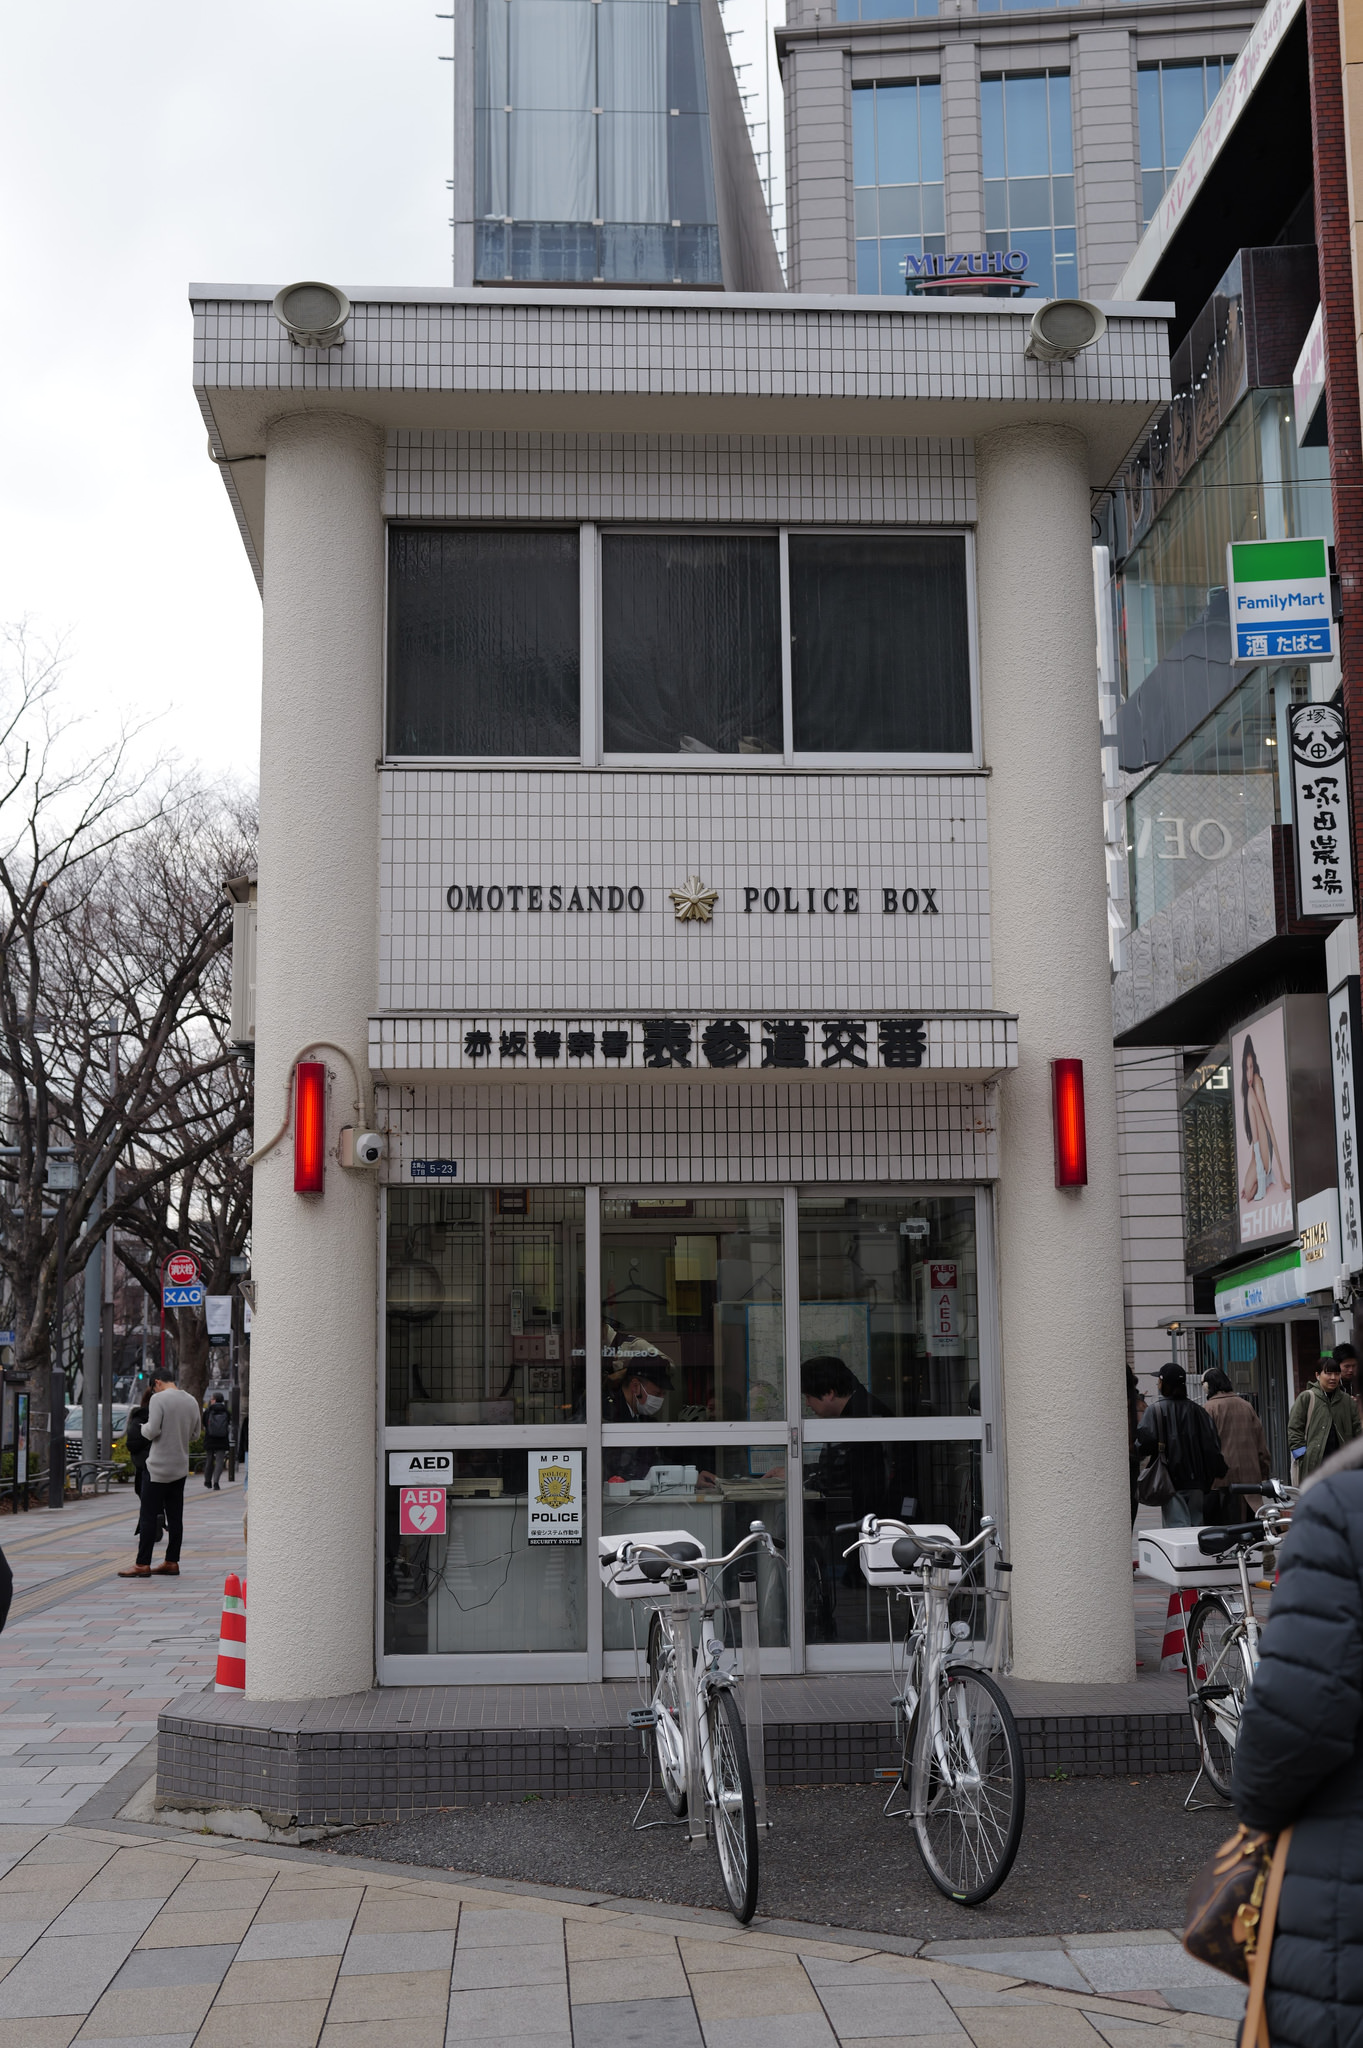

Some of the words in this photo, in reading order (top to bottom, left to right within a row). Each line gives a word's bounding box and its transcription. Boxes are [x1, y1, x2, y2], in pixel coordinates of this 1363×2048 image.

[1166, 156, 1198, 229] バレエ
[1203, 55, 1249, 164] スタジオ
[904, 249, 1029, 276] MIZUHO
[1237, 590, 1325, 612] FamilyMart
[1246, 635, 1268, 656] 酒
[1276, 634, 1323, 653] たばこ
[1306, 708, 1327, 724] 塚
[1302, 777, 1343, 895] 塚田農場
[446, 885, 645, 912] OMOTESANDO
[744, 887, 859, 913] POLICE
[883, 888, 940, 914] BOX
[464, 1030, 629, 1058] 赤坂警察署
[643, 1018, 928, 1068] 表参道交番
[430, 1164, 453, 1173] 5-23
[1242, 1199, 1293, 1238] SHIMA
[1300, 1221, 1328, 1251] SHIMA
[171, 1264, 193, 1275] 消火栓
[939, 1294, 951, 1333] AED
[409, 1457, 450, 1469] AED
[404, 1490, 442, 1503] AED
[531, 1513, 579, 1522] POLICE
